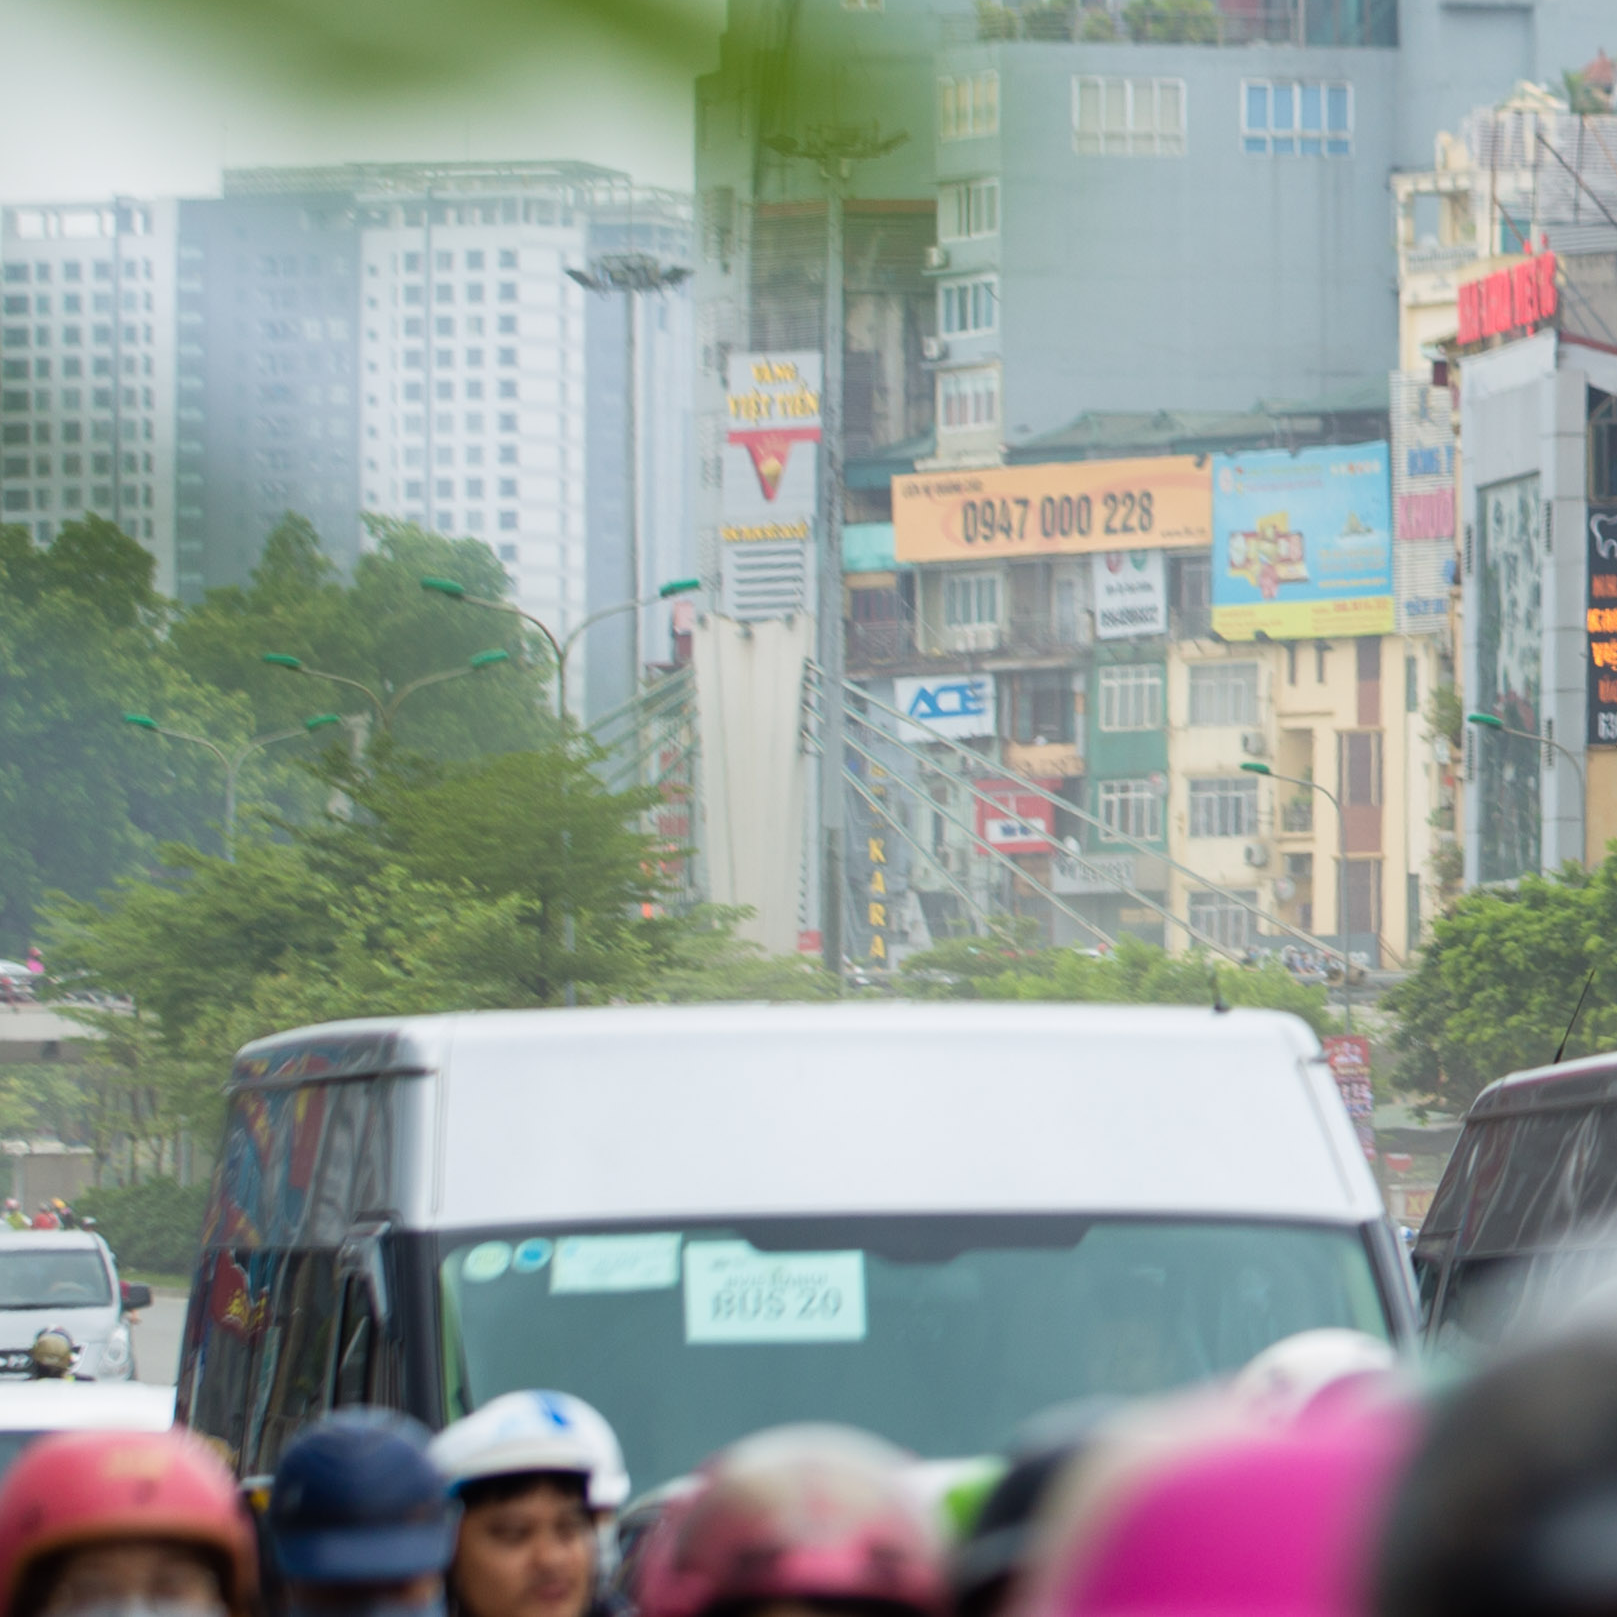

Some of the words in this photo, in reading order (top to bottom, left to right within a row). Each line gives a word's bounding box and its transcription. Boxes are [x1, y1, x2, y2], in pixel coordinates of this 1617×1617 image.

[962, 497, 1031, 544] 0947
[1040, 493, 1093, 539] 000
[1103, 489, 1154, 536] 228
[711, 1286, 786, 1322] BUS
